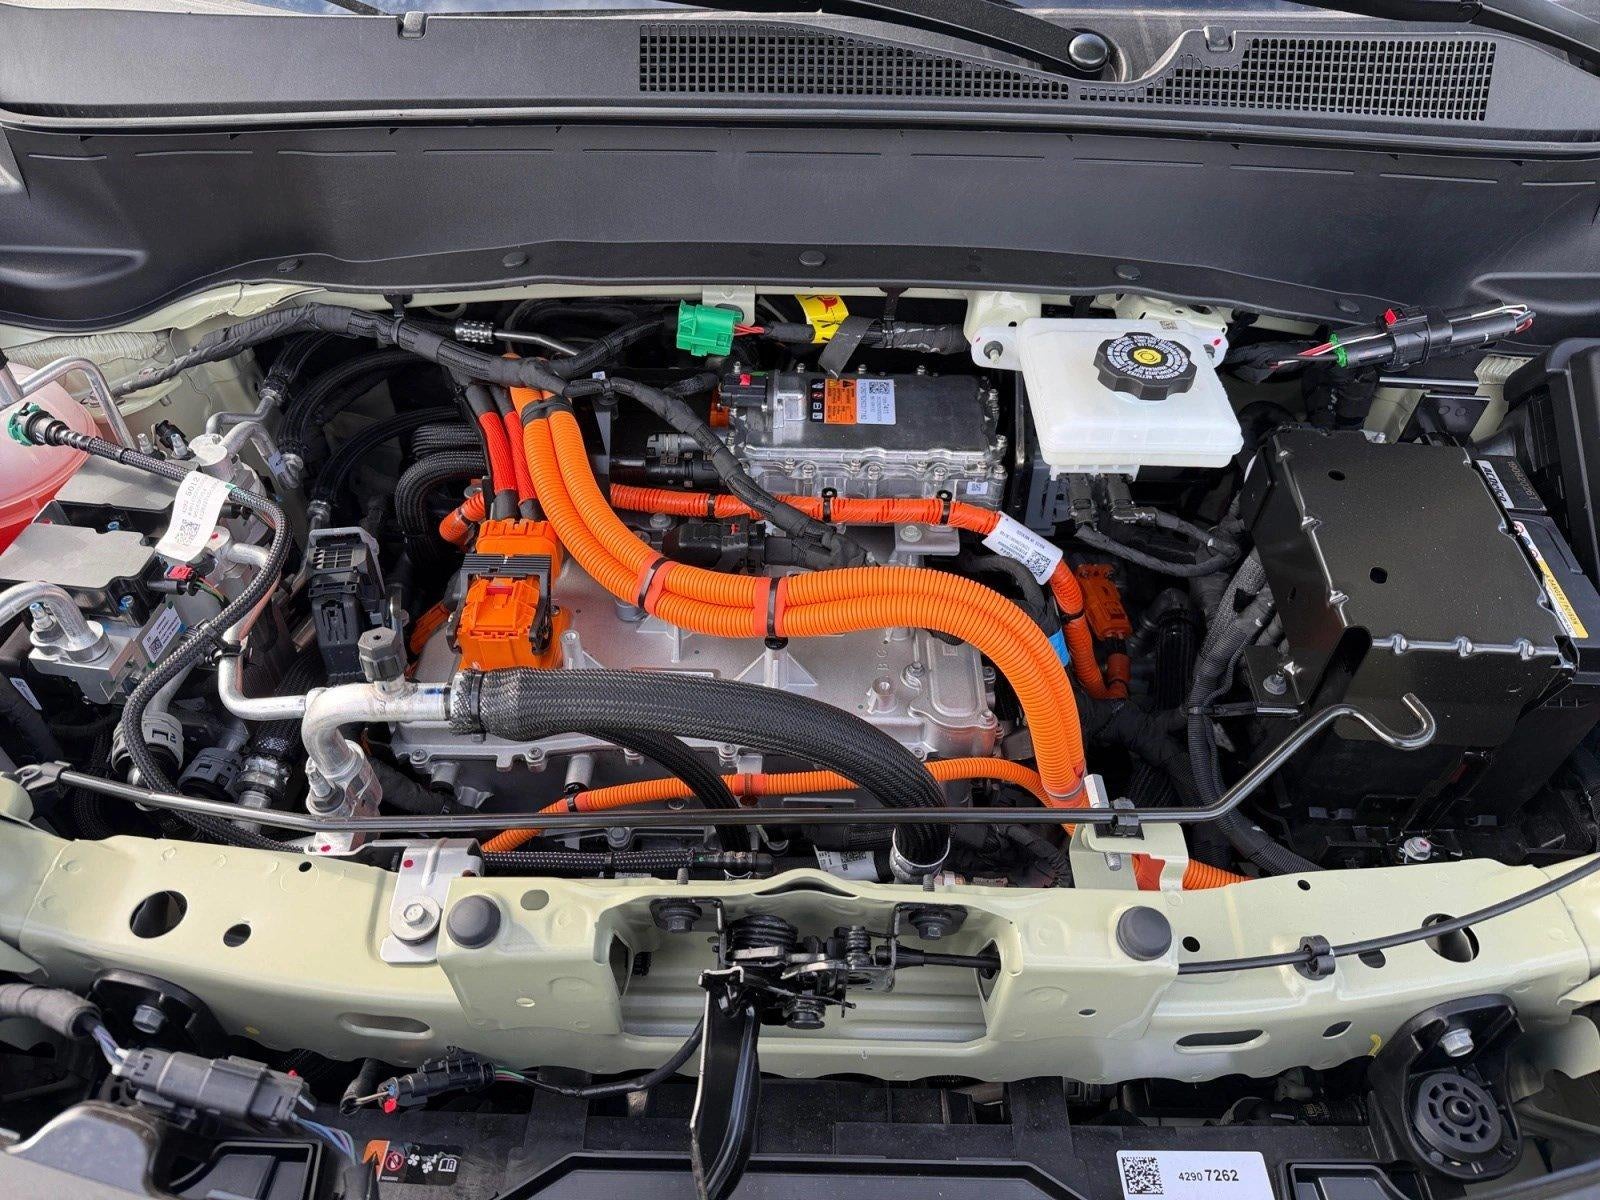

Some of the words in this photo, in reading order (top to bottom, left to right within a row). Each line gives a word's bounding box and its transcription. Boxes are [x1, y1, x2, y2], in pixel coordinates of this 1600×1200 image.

[1482, 466, 1507, 502] ACDelco
[1178, 1172, 1203, 1181] 4290
[1204, 1170, 1239, 1181] 7262
